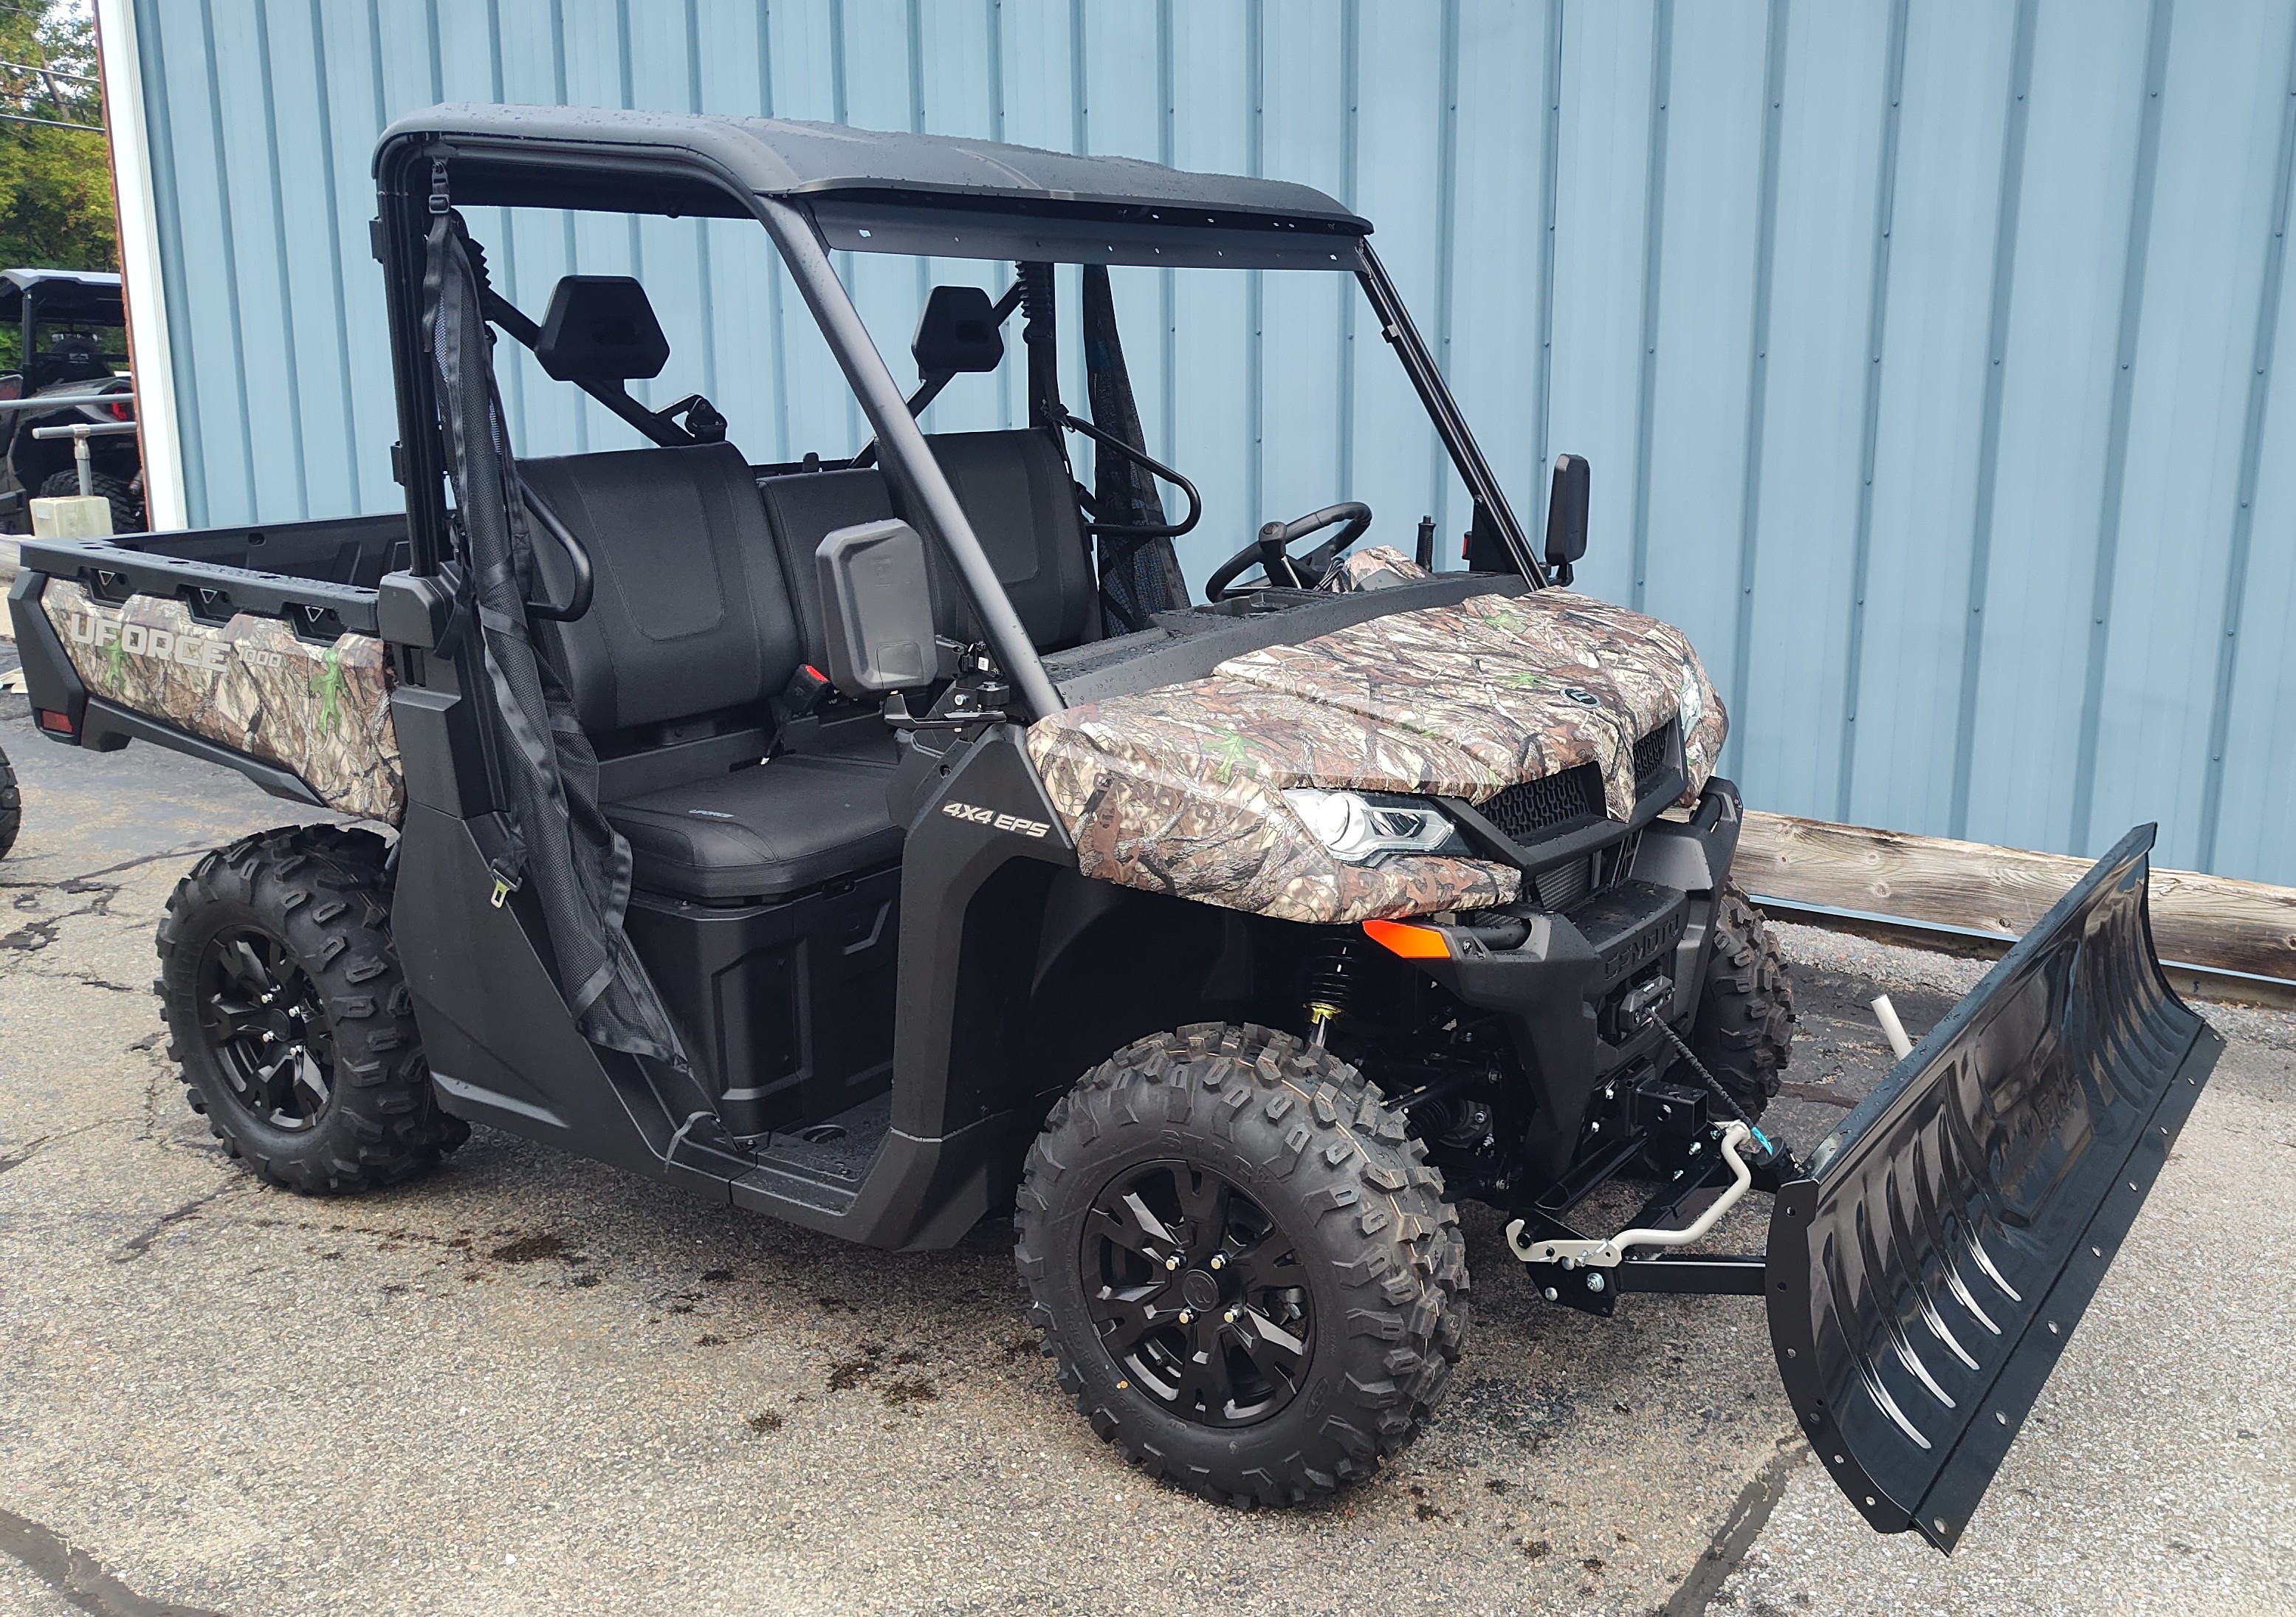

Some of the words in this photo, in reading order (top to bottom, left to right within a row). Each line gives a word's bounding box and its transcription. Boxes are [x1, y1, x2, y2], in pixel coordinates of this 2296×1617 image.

[70, 614, 231, 673] UFORCE
[238, 647, 281, 668] 1000
[942, 803, 994, 825] 4X4
[994, 814, 1051, 839] EPS
